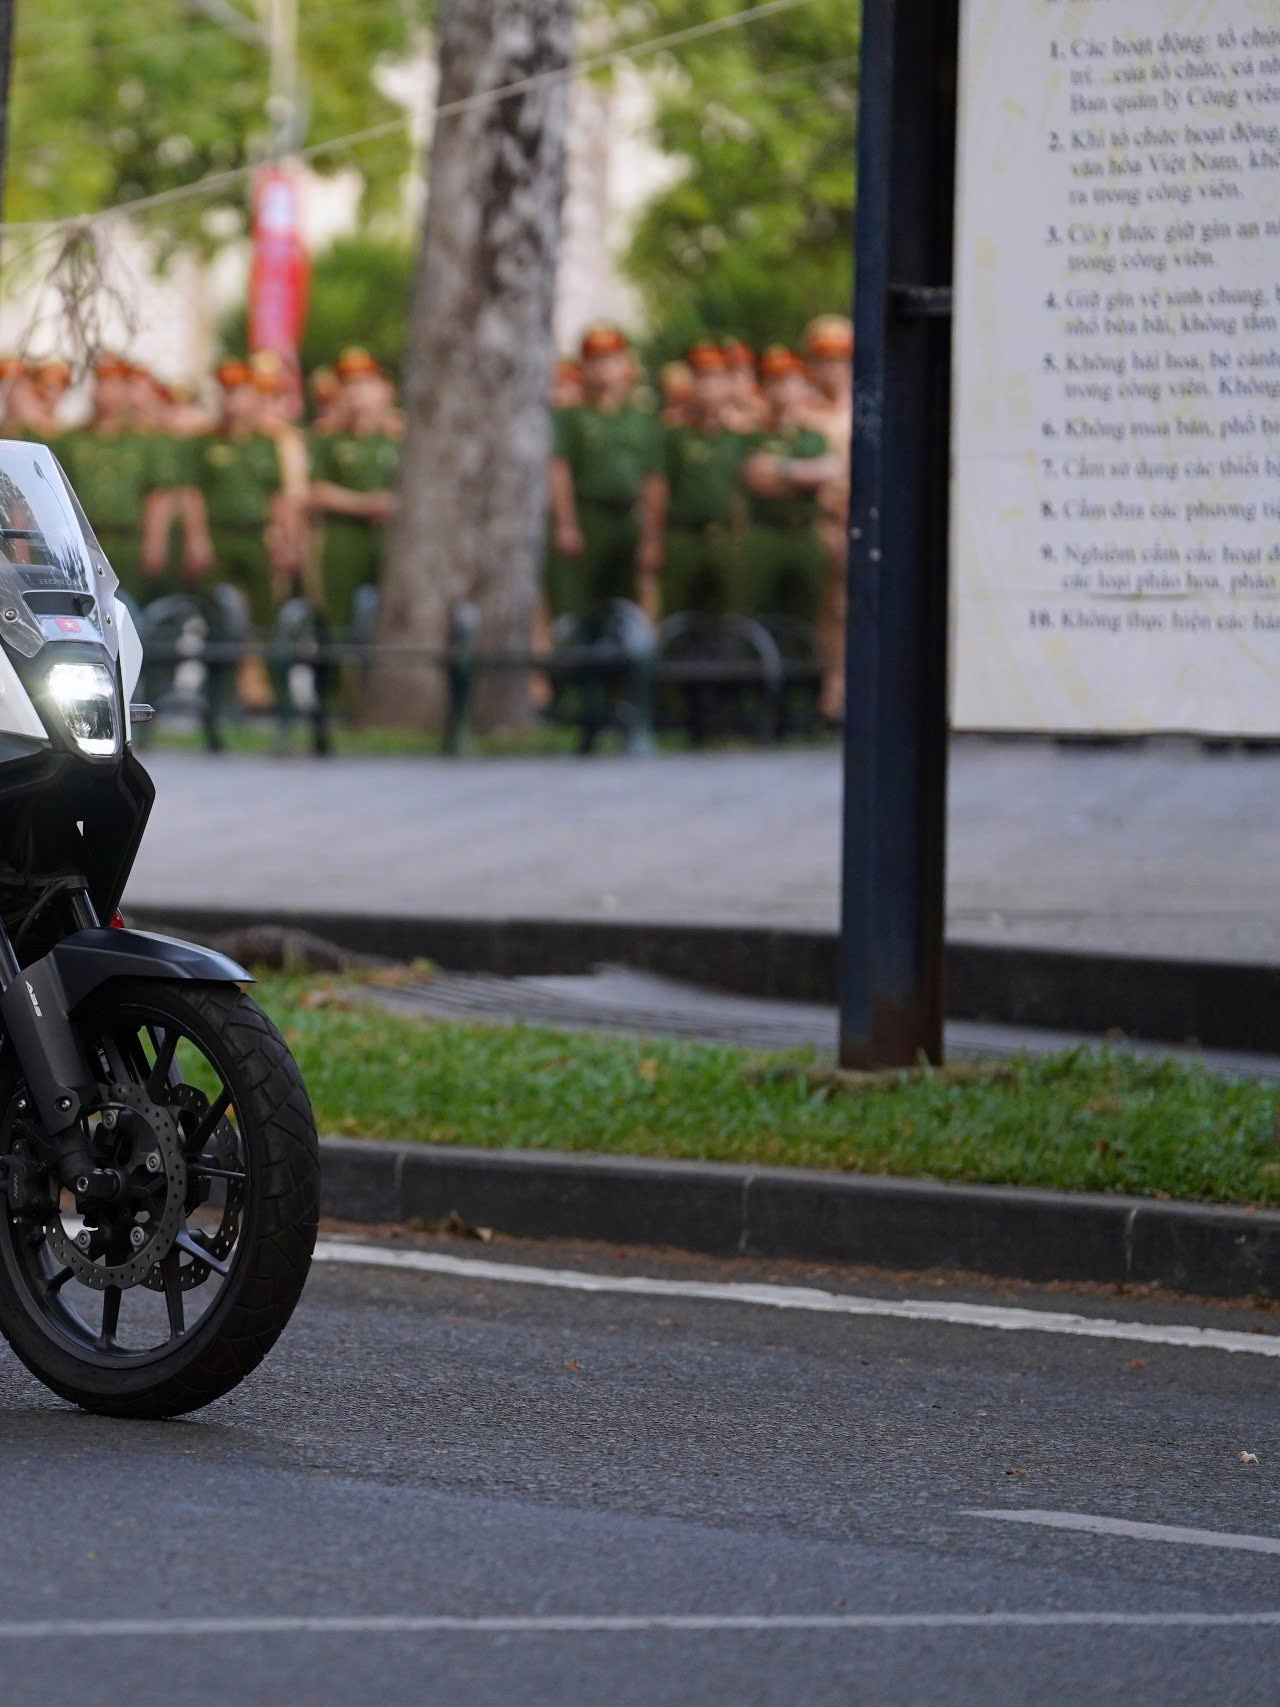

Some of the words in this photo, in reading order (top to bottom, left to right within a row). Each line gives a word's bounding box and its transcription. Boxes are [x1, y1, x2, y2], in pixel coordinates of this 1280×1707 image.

[1065, 351, 1125, 375] Không
[1065, 416, 1125, 442] Không
[1062, 608, 1121, 634] Không
